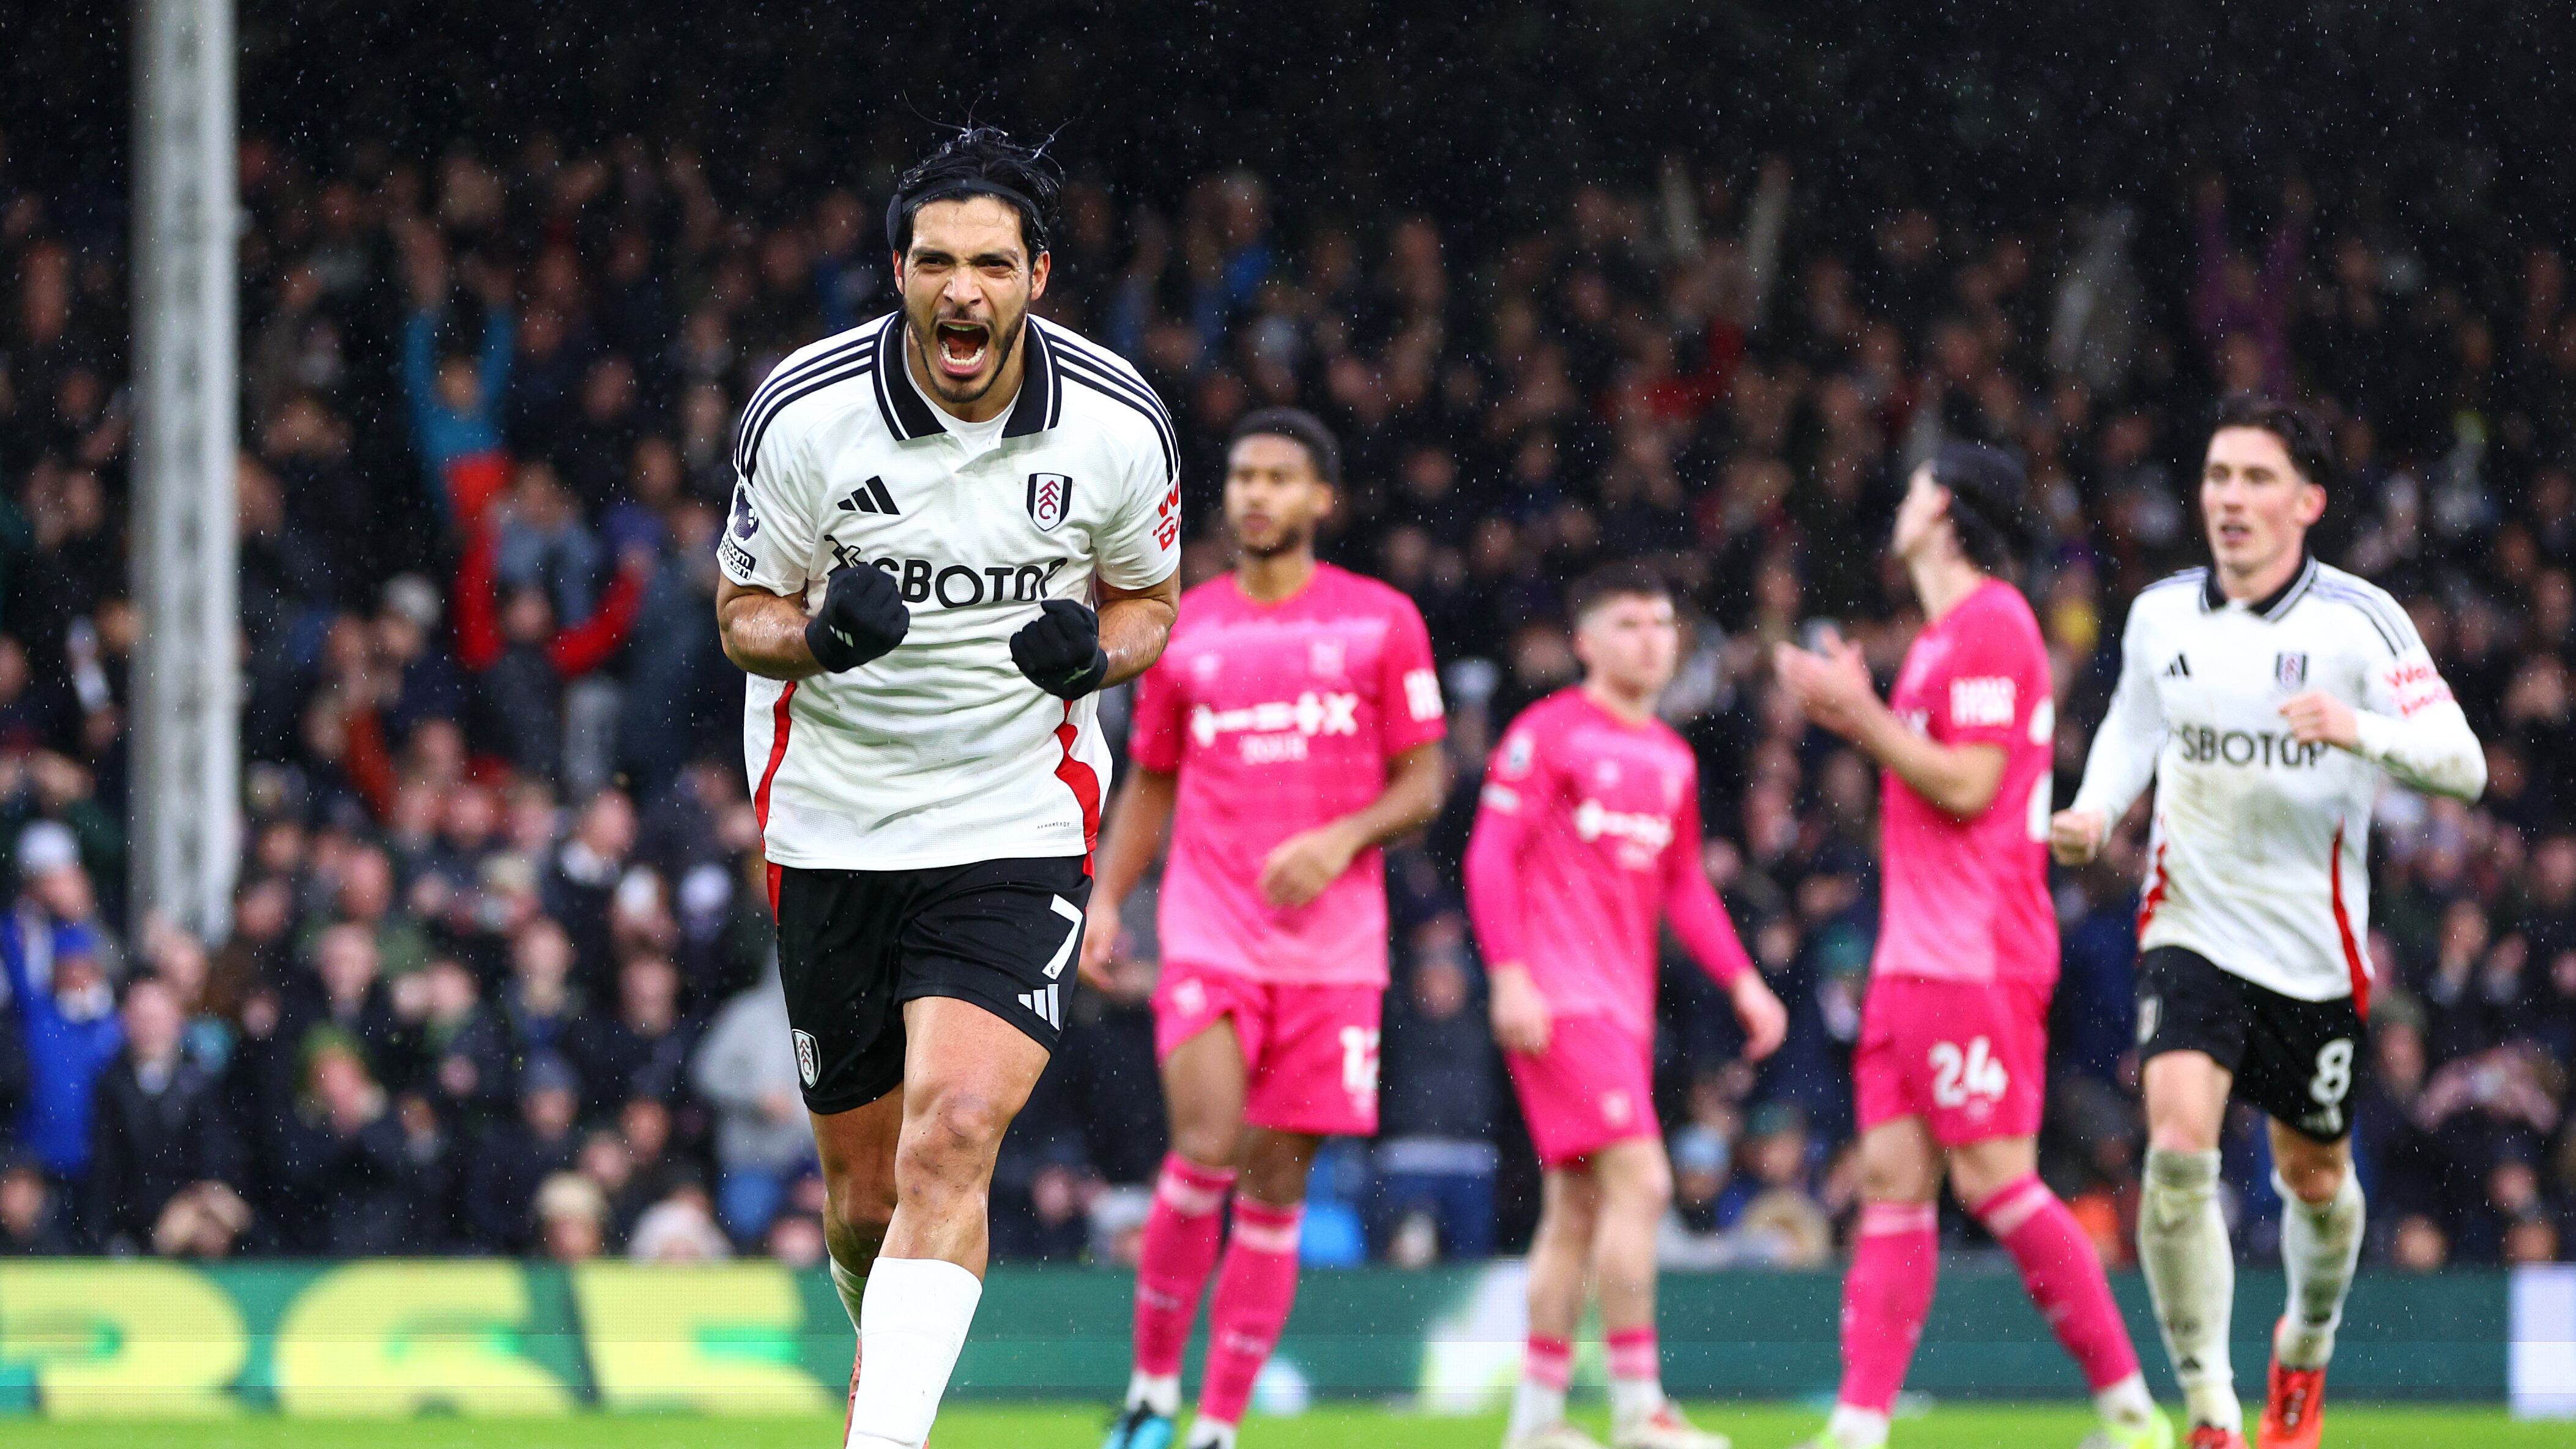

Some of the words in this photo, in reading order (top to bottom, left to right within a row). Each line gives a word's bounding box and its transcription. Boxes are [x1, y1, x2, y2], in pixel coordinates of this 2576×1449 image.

[1037, 480, 1060, 520] FFC
[724, 549, 751, 580] racism
[727, 540, 750, 567] room
[1042, 893, 1083, 980] 7
[1929, 1035, 2008, 1108] 24
[2309, 1038, 2355, 1106] 8
